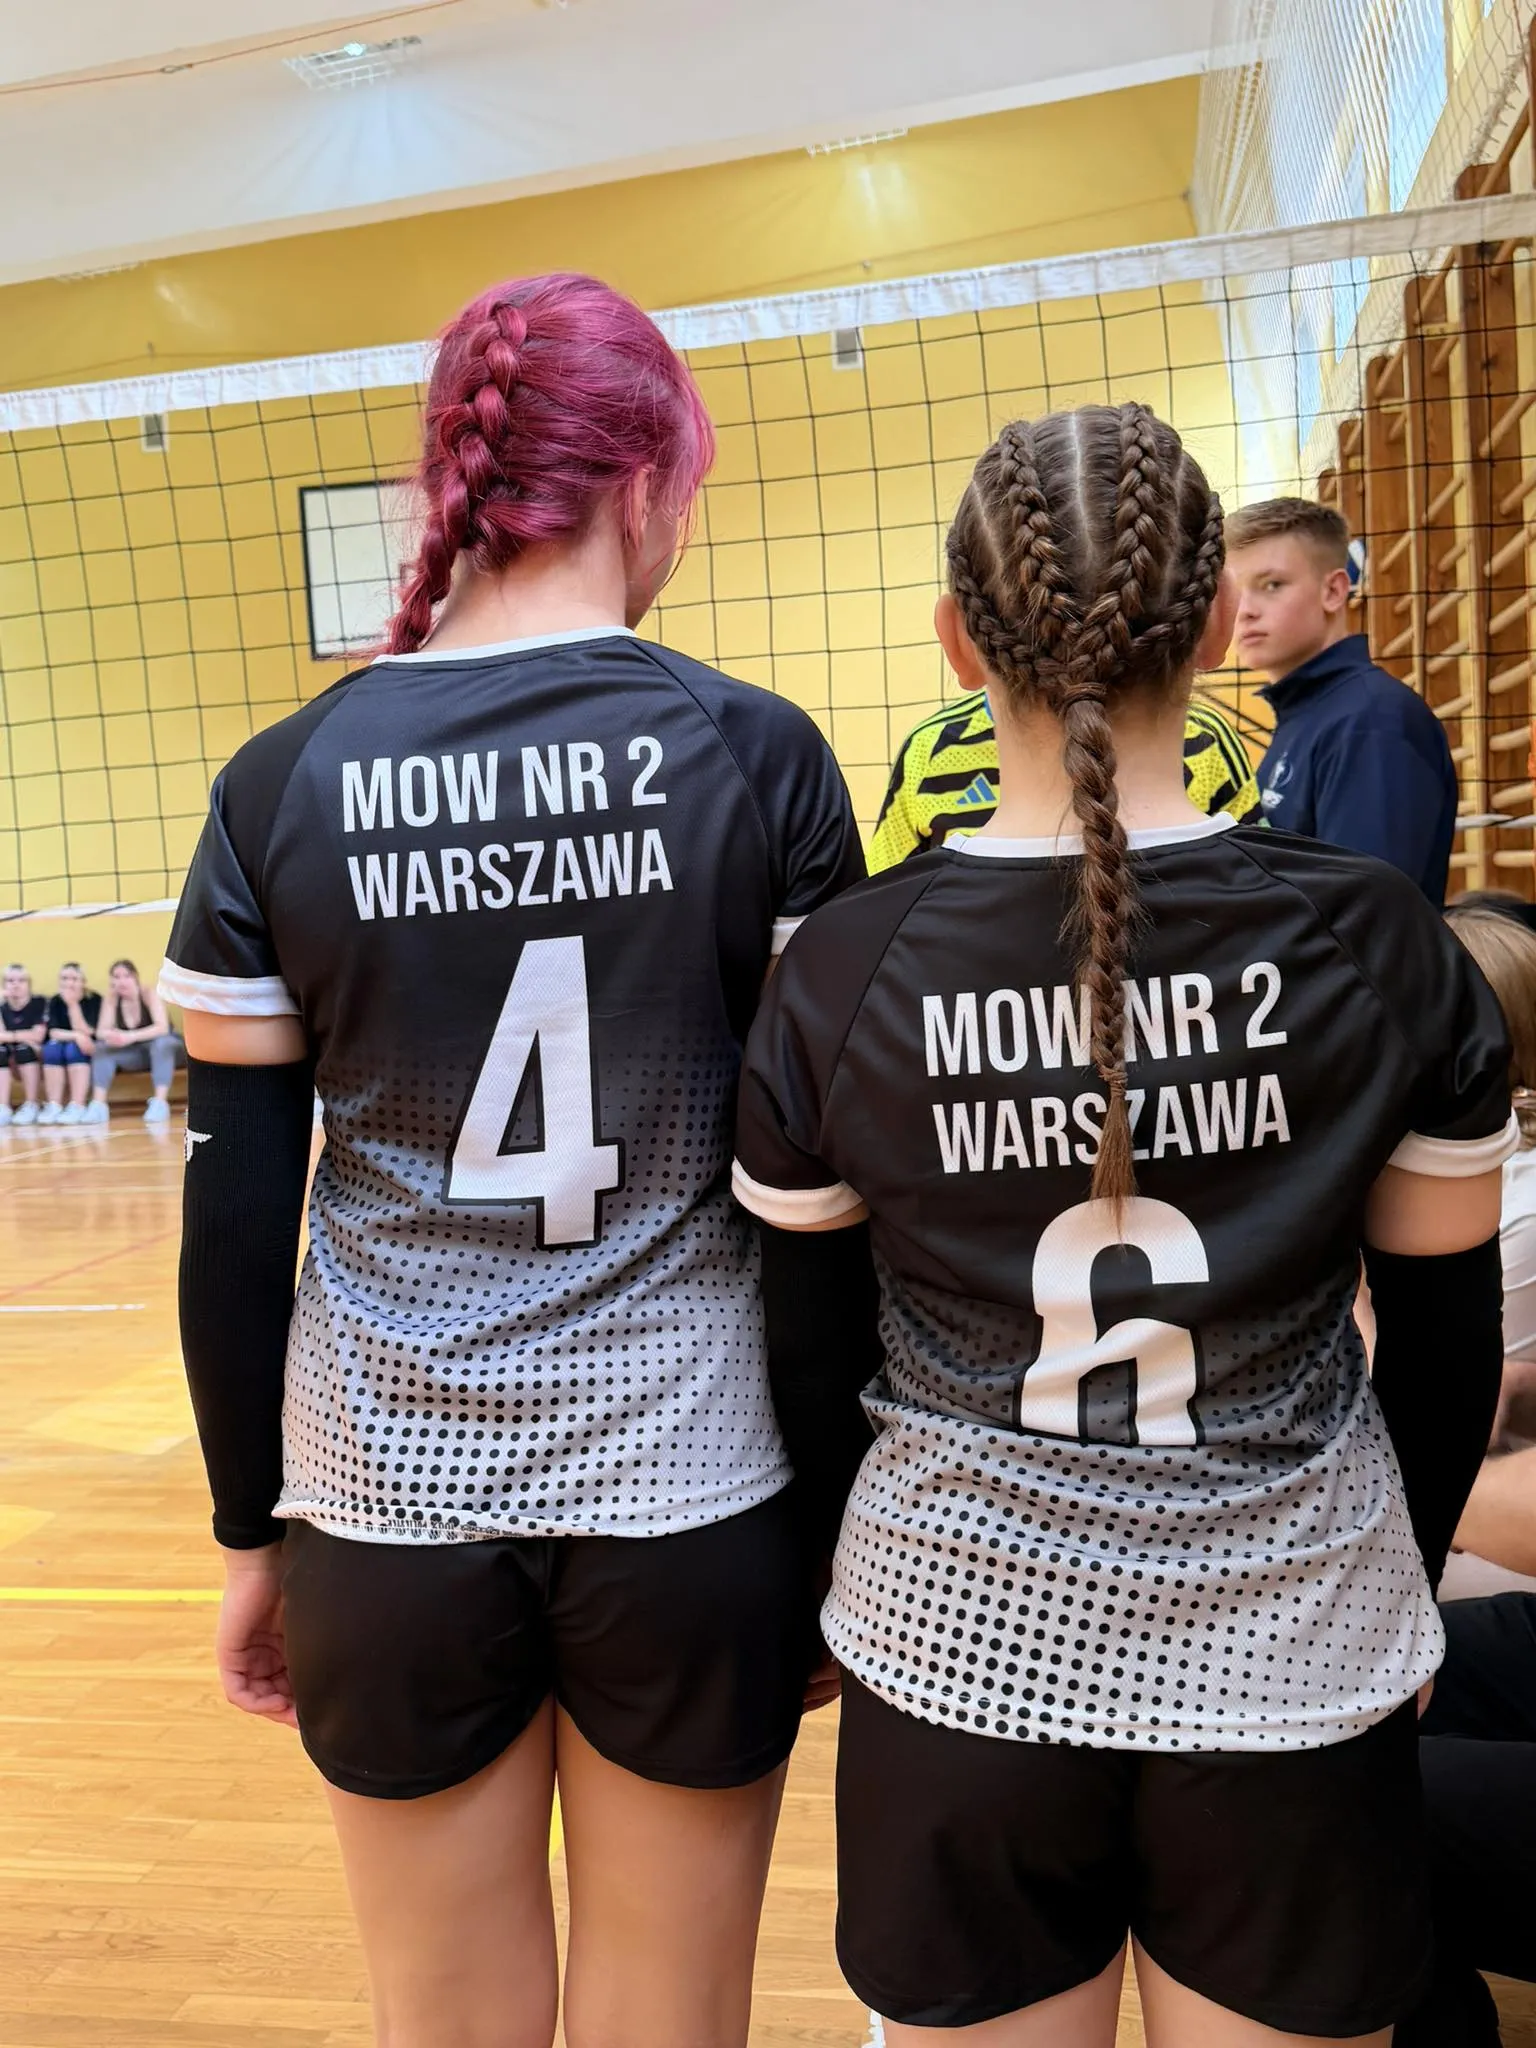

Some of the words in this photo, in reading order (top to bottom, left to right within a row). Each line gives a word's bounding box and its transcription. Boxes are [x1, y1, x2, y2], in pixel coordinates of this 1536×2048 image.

[342, 749, 499, 833] MOW
[520, 741, 610, 818] NR
[627, 735, 667, 807] 2
[347, 828, 674, 921] WARSZAWA
[922, 983, 1093, 1077] MOW
[1120, 972, 1220, 1063] NR
[1240, 961, 1288, 1049] 2
[447, 935, 619, 1246] 4
[932, 1074, 1291, 1174] WARSZAWA
